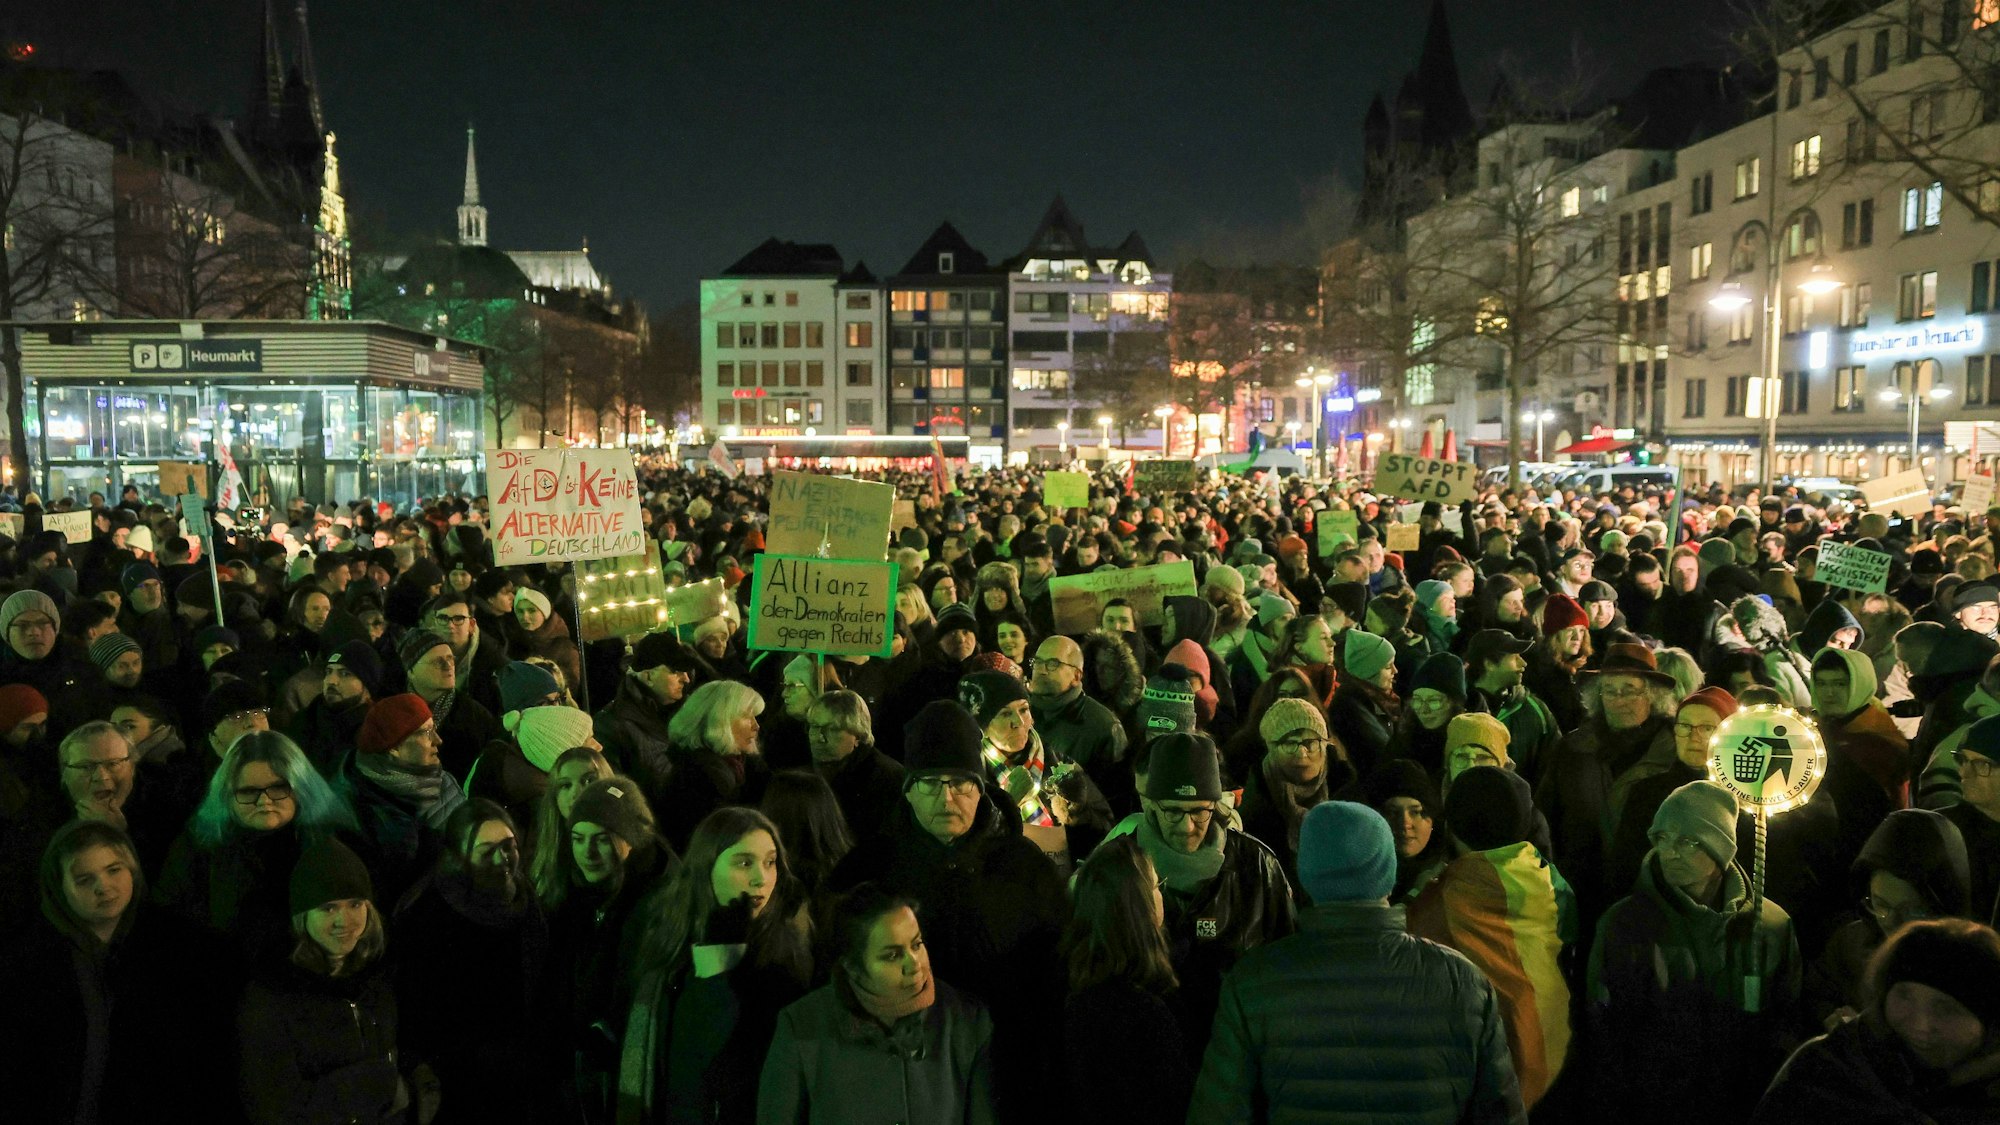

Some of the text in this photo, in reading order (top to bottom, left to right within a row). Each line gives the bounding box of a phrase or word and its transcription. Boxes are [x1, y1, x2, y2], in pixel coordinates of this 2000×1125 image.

[191, 350, 256, 362] Heumarkt
[1385, 455, 1467, 480] STOPPT
[497, 469, 558, 506] AfD
[565, 475, 578, 495] ist
[1400, 478, 1451, 497] AFD
[525, 530, 641, 556] DEUTSCHLAND
[1821, 542, 1889, 566] FASCHISTEN
[766, 558, 869, 597] Allianz
[1817, 561, 1883, 584] FASCHISTEN
[761, 595, 886, 622] der Demokraten
[777, 623, 883, 649] gegen Rechts
[1714, 754, 1815, 803] HALTE DEINE UMWELT SAUBER
[1196, 920, 1217, 929] FCK
[1196, 928, 1217, 937] NZS
